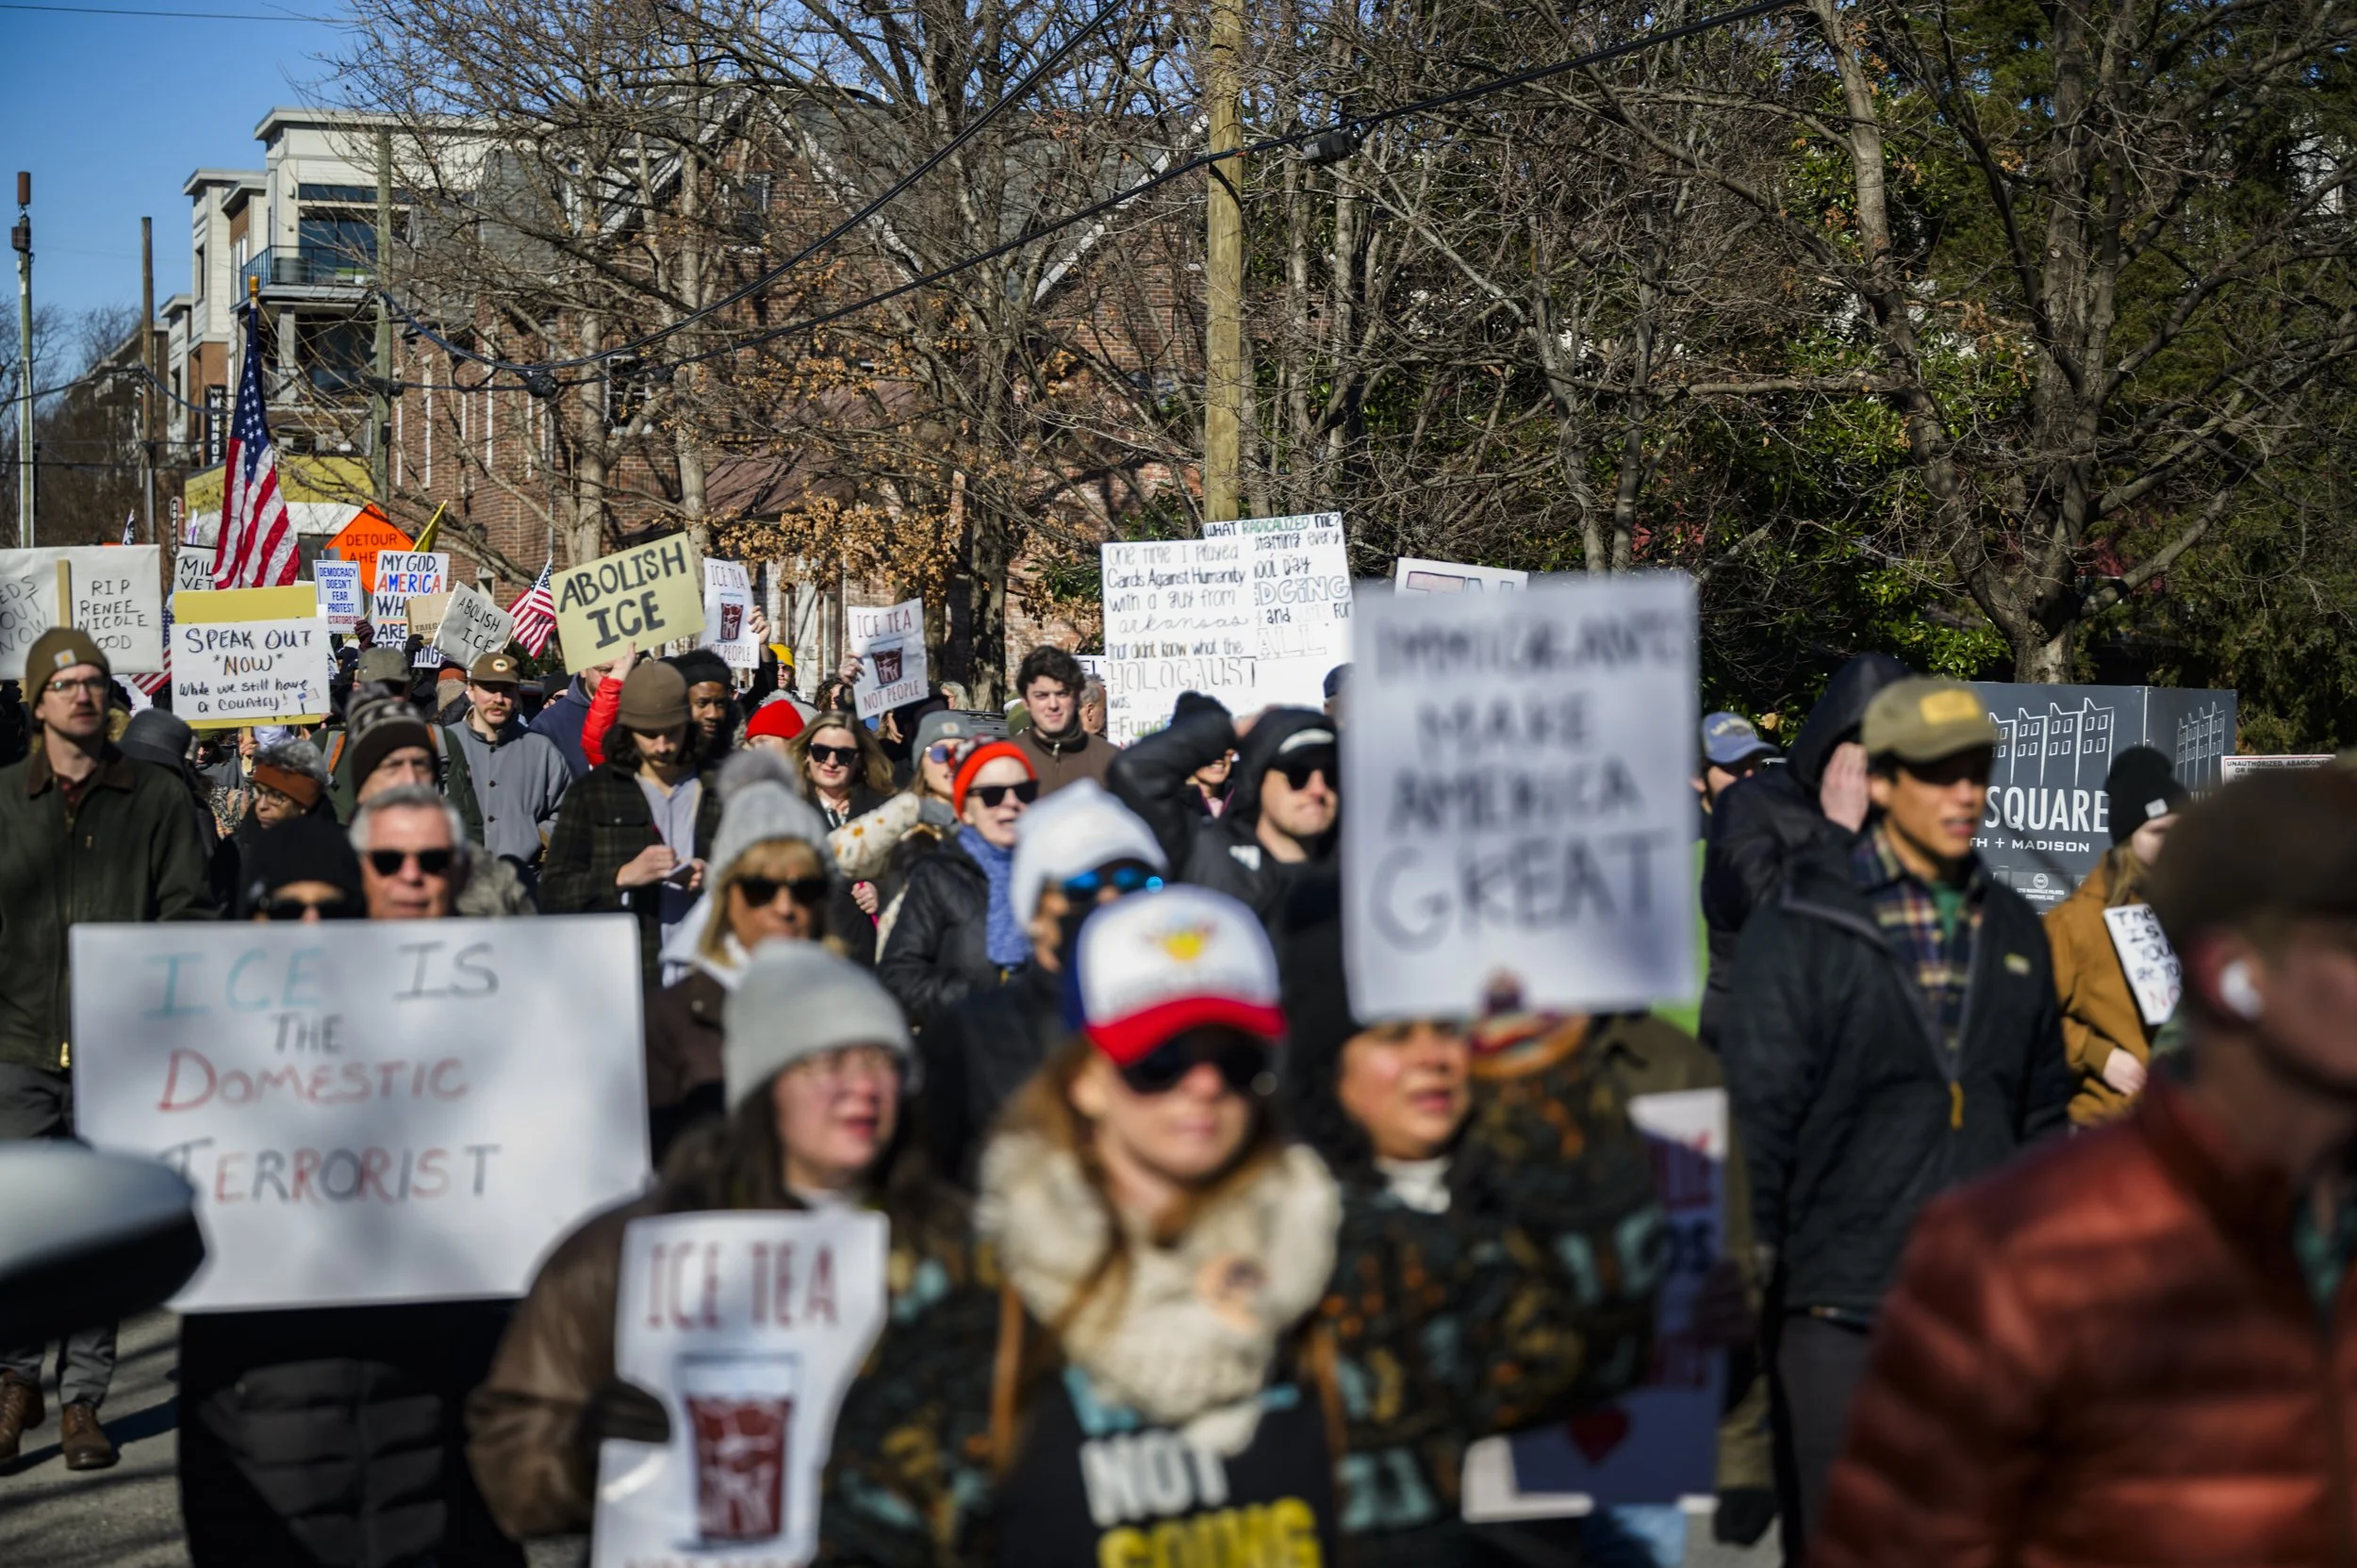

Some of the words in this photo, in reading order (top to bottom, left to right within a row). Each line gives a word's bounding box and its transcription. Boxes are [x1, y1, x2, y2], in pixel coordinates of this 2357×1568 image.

[1205, 521, 1239, 537] WHAT
[1242, 516, 1310, 535] RADICALIZED
[1314, 514, 1340, 528] ME?
[346, 534, 397, 546] DETOUR
[349, 553, 377, 563] AHE
[381, 554, 404, 571] MY
[406, 554, 438, 573] GOD,
[1181, 545, 1187, 563] I
[180, 557, 214, 576] MIL
[319, 567, 356, 578] DEMOCRACY
[559, 541, 686, 613] ABOLISH
[710, 565, 728, 586] ICE
[91, 579, 130, 596] RIP
[325, 579, 352, 589] DOESN'T
[377, 573, 441, 593] AMERICA
[1107, 568, 1145, 589] Cards
[1146, 568, 1189, 589] Against
[1192, 566, 1245, 587] Humanity
[0, 575, 37, 604] EDS
[332, 591, 349, 601] FEAR
[1201, 588, 1235, 607] from
[0, 589, 40, 630] OUT
[80, 600, 140, 617] RENEE
[327, 602, 354, 613] PROTEST
[376, 595, 407, 617] WH
[457, 597, 501, 633] ABOLISH
[77, 614, 148, 631] NICOLE
[327, 616, 352, 624] CTATORS
[415, 622, 440, 632] TAILG
[585, 590, 666, 649] ICE
[856, 615, 879, 638] ICE
[886, 608, 912, 634] TEA
[0, 610, 47, 655] NOW
[185, 627, 255, 653] SPEAK
[265, 629, 312, 650] OUT
[376, 623, 407, 639] ARE
[461, 627, 495, 653] ICE
[96, 635, 132, 650] OOD
[723, 644, 750, 662] PEOPLE
[1162, 639, 1187, 657] know
[1192, 637, 1218, 655] what
[1223, 636, 1244, 654] the
[1109, 656, 1257, 694] HOLOCAUST
[179, 681, 209, 697] While
[217, 685, 235, 695] we
[241, 678, 269, 691] still
[275, 678, 308, 691] have
[863, 692, 884, 712] NOT
[886, 680, 920, 703] PEOPLE
[198, 701, 209, 714] a
[1420, 692, 1594, 756] MAKE
[1387, 760, 1644, 835] AMERICA
[1985, 785, 2109, 833] SQUARE
[1970, 837, 1987, 848] TH
[2012, 839, 2090, 852] MADISON
[1370, 829, 1674, 954] GREAT
[140, 947, 325, 1019] ICE
[393, 941, 500, 1001] IS
[271, 1013, 343, 1054] THE
[157, 1048, 470, 1112] DOMESTIC
[159, 1138, 502, 1204] TERRORIST
[646, 1242, 723, 1330] ICE
[750, 1242, 838, 1329] TEA
[1080, 1429, 1229, 1527] NOT
